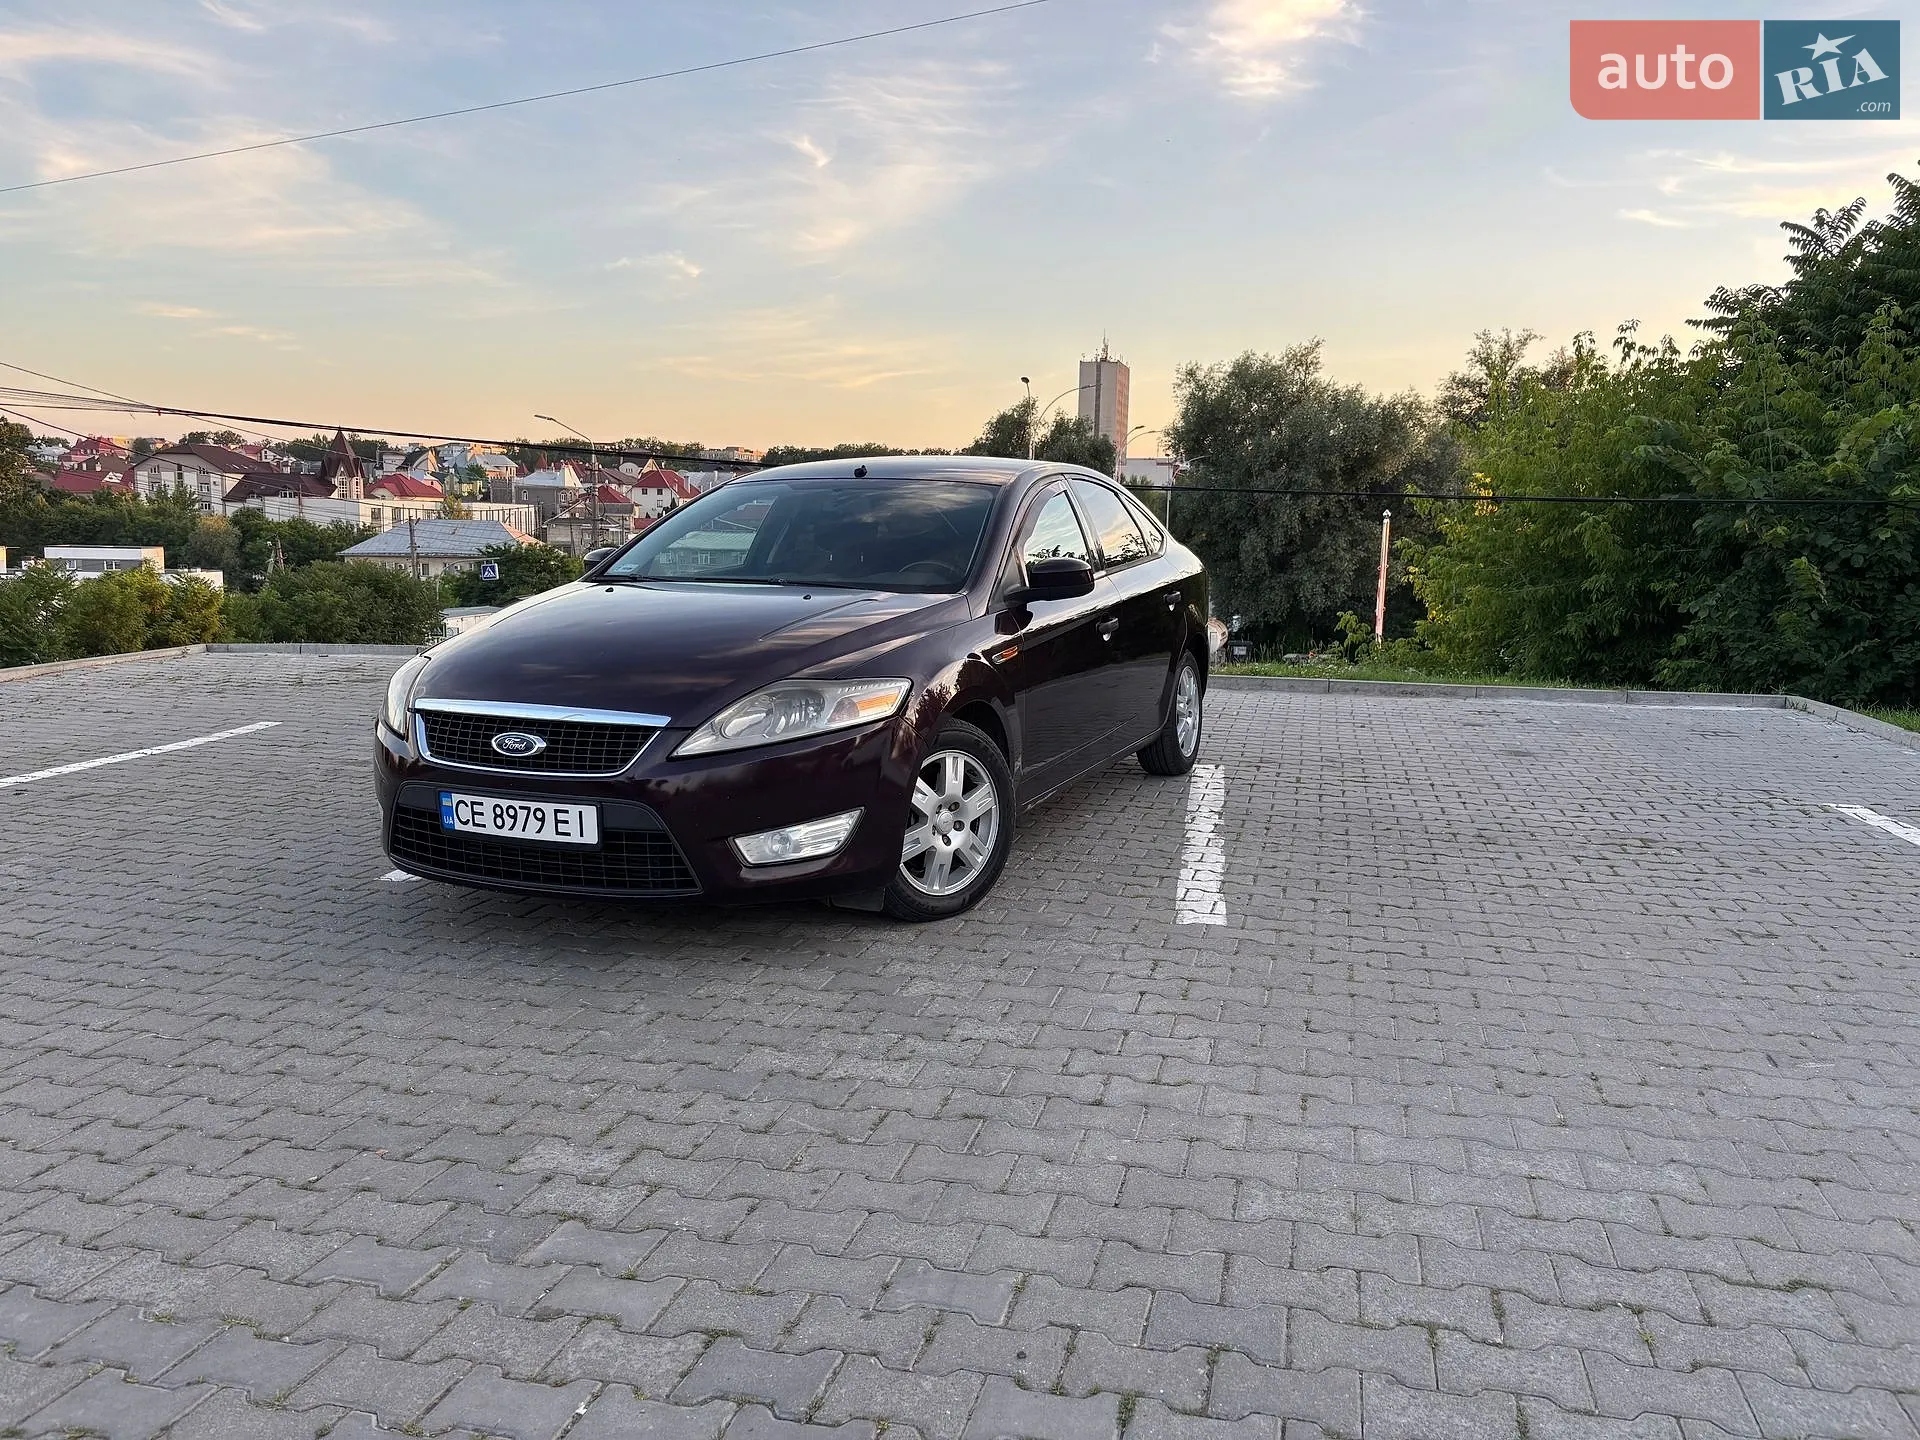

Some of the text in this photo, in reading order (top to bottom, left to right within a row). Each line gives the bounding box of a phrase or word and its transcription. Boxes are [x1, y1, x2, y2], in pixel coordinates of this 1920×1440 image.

[503, 738, 527, 750] Ford
[444, 817, 454, 825] UA
[455, 799, 584, 838] CE 8979 EI
